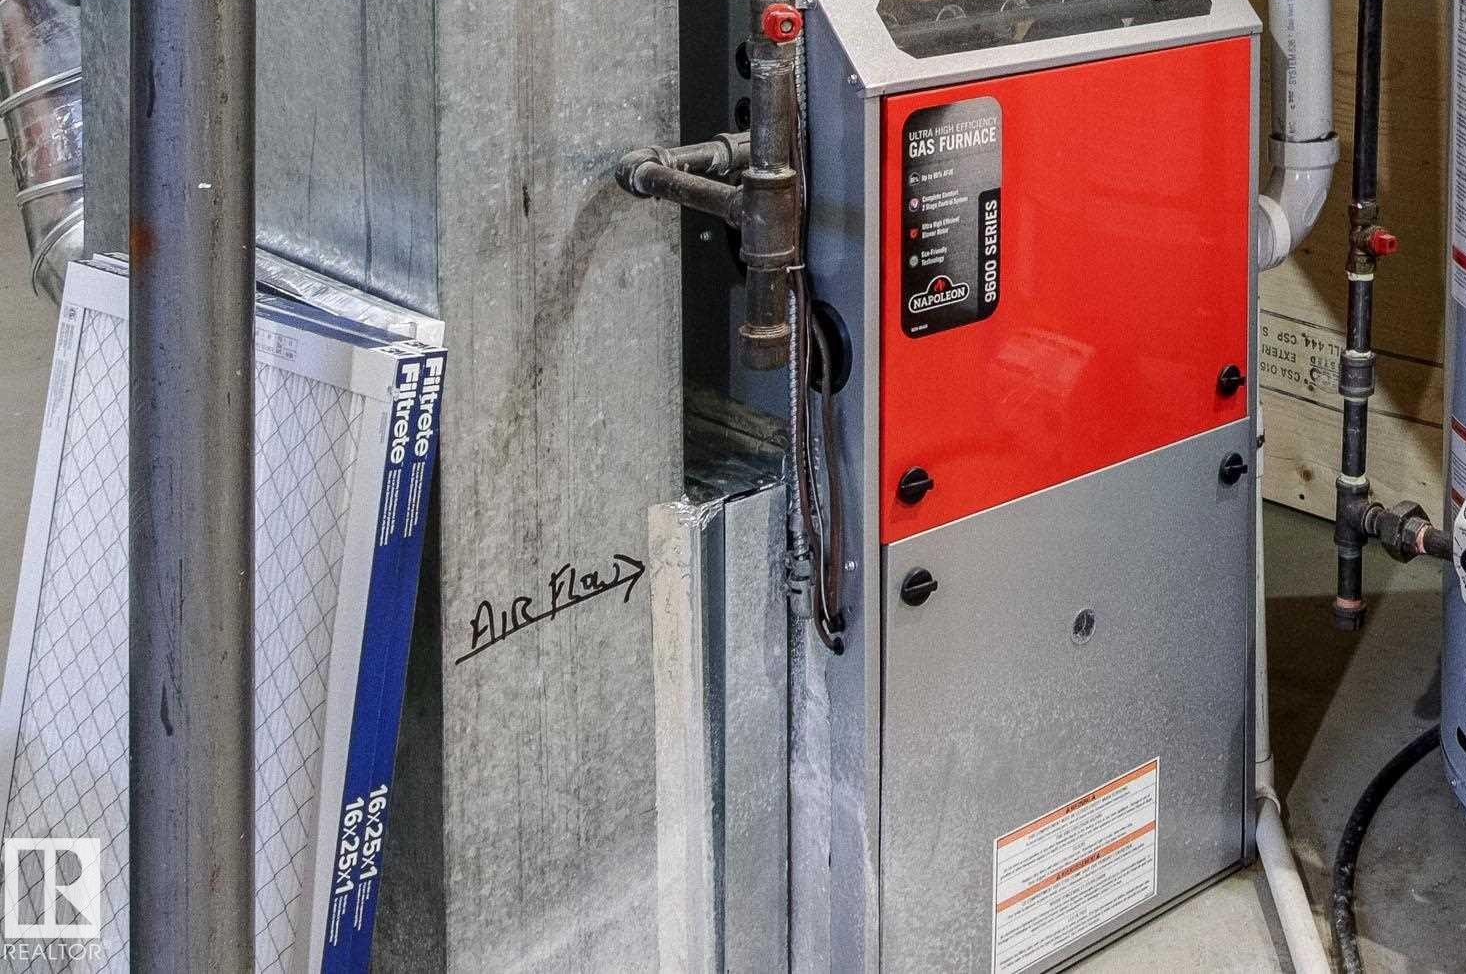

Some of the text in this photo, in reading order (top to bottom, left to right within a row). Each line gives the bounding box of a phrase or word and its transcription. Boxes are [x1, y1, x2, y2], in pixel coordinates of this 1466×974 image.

[1288, 54, 1296, 85] SYSTEM
[909, 117, 997, 141] ULTRA HIGH EFFICIENCY
[909, 126, 996, 158] GAS FURNACE
[921, 246, 948, 258] Eco-Friendly
[921, 256, 945, 266] Technology
[985, 200, 997, 303] 9600 SERIES
[913, 286, 966, 309] NAPOLEON
[1277, 332, 1297, 345] CSP
[1281, 368, 1300, 382] CSA
[390, 362, 420, 464] Filtrete
[414, 357, 443, 456] Filtrete
[471, 597, 535, 649] AIR
[335, 797, 365, 894] 16x25x1
[359, 784, 389, 880] 16x25x1
